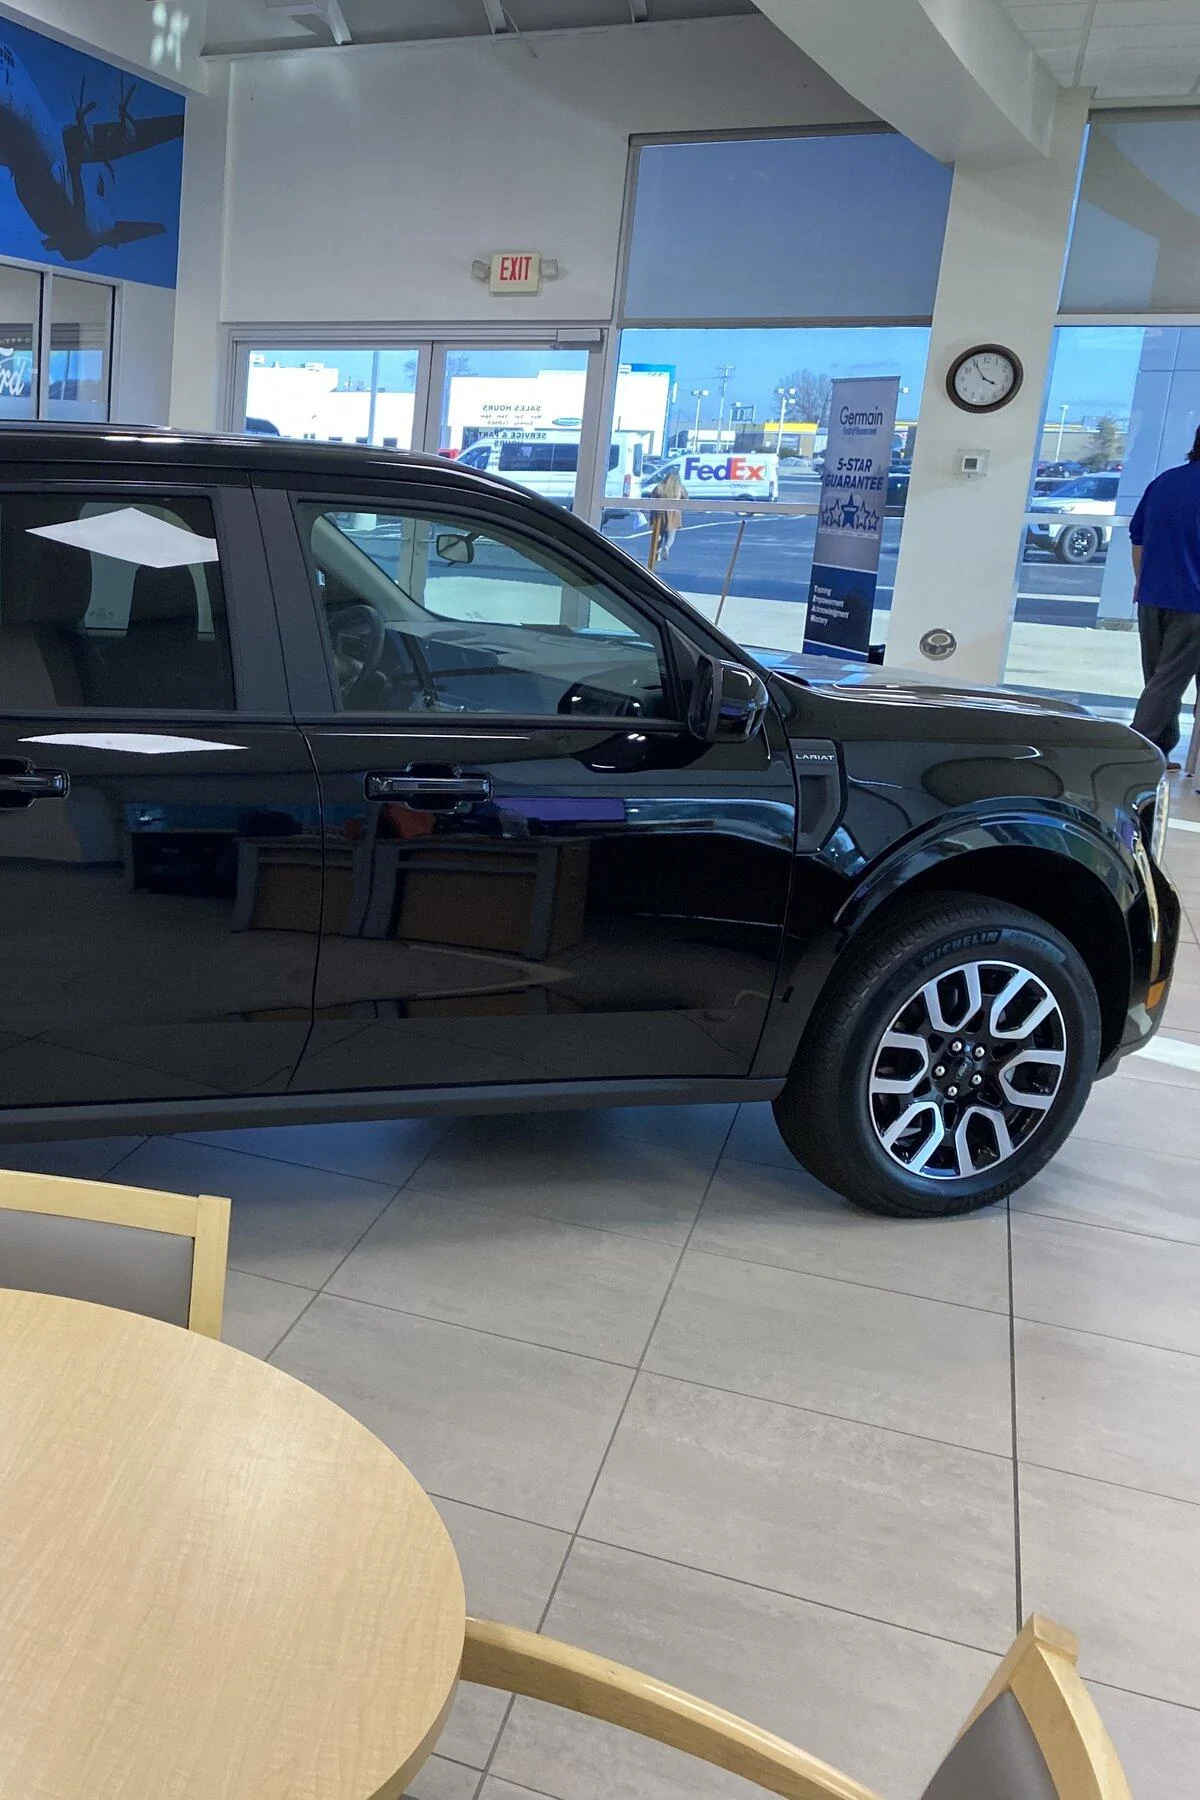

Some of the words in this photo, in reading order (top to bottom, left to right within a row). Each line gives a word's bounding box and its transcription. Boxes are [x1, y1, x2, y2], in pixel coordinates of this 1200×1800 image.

[499, 256, 532, 280] EXIT
[840, 406, 883, 426] Germain
[684, 457, 765, 481] FedEx
[836, 458, 872, 472] 5-STAR
[824, 474, 884, 490] GUARANTEE
[922, 930, 1000, 967] MICHELIN
